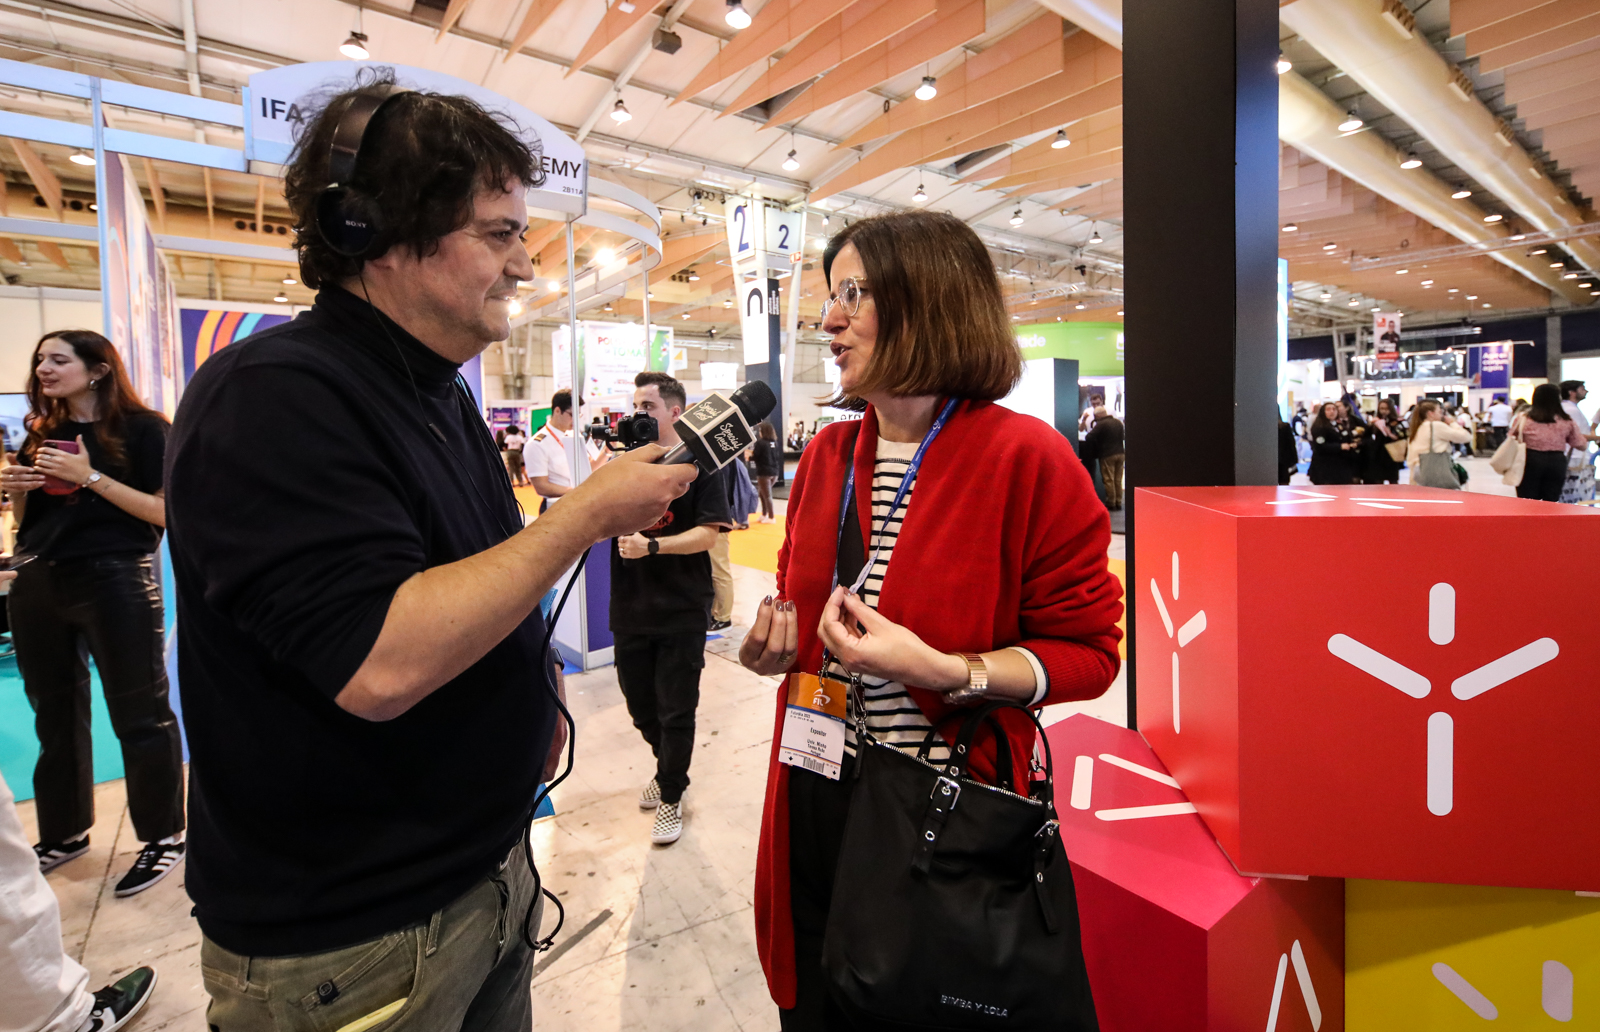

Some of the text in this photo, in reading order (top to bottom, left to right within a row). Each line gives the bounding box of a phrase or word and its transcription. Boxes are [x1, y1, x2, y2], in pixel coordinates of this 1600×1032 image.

[540, 156, 582, 179] EMY
[345, 220, 367, 228] SONY
[734, 205, 749, 253] 2
[778, 224, 789, 250] 2
[699, 401, 721, 417] Special
[714, 432, 735, 452] Guest
[720, 422, 743, 449] Special
[813, 697, 823, 706] FIL
[810, 727, 827, 736] Expositor
[940, 994, 1008, 1018] BIMBA Y LOLA
